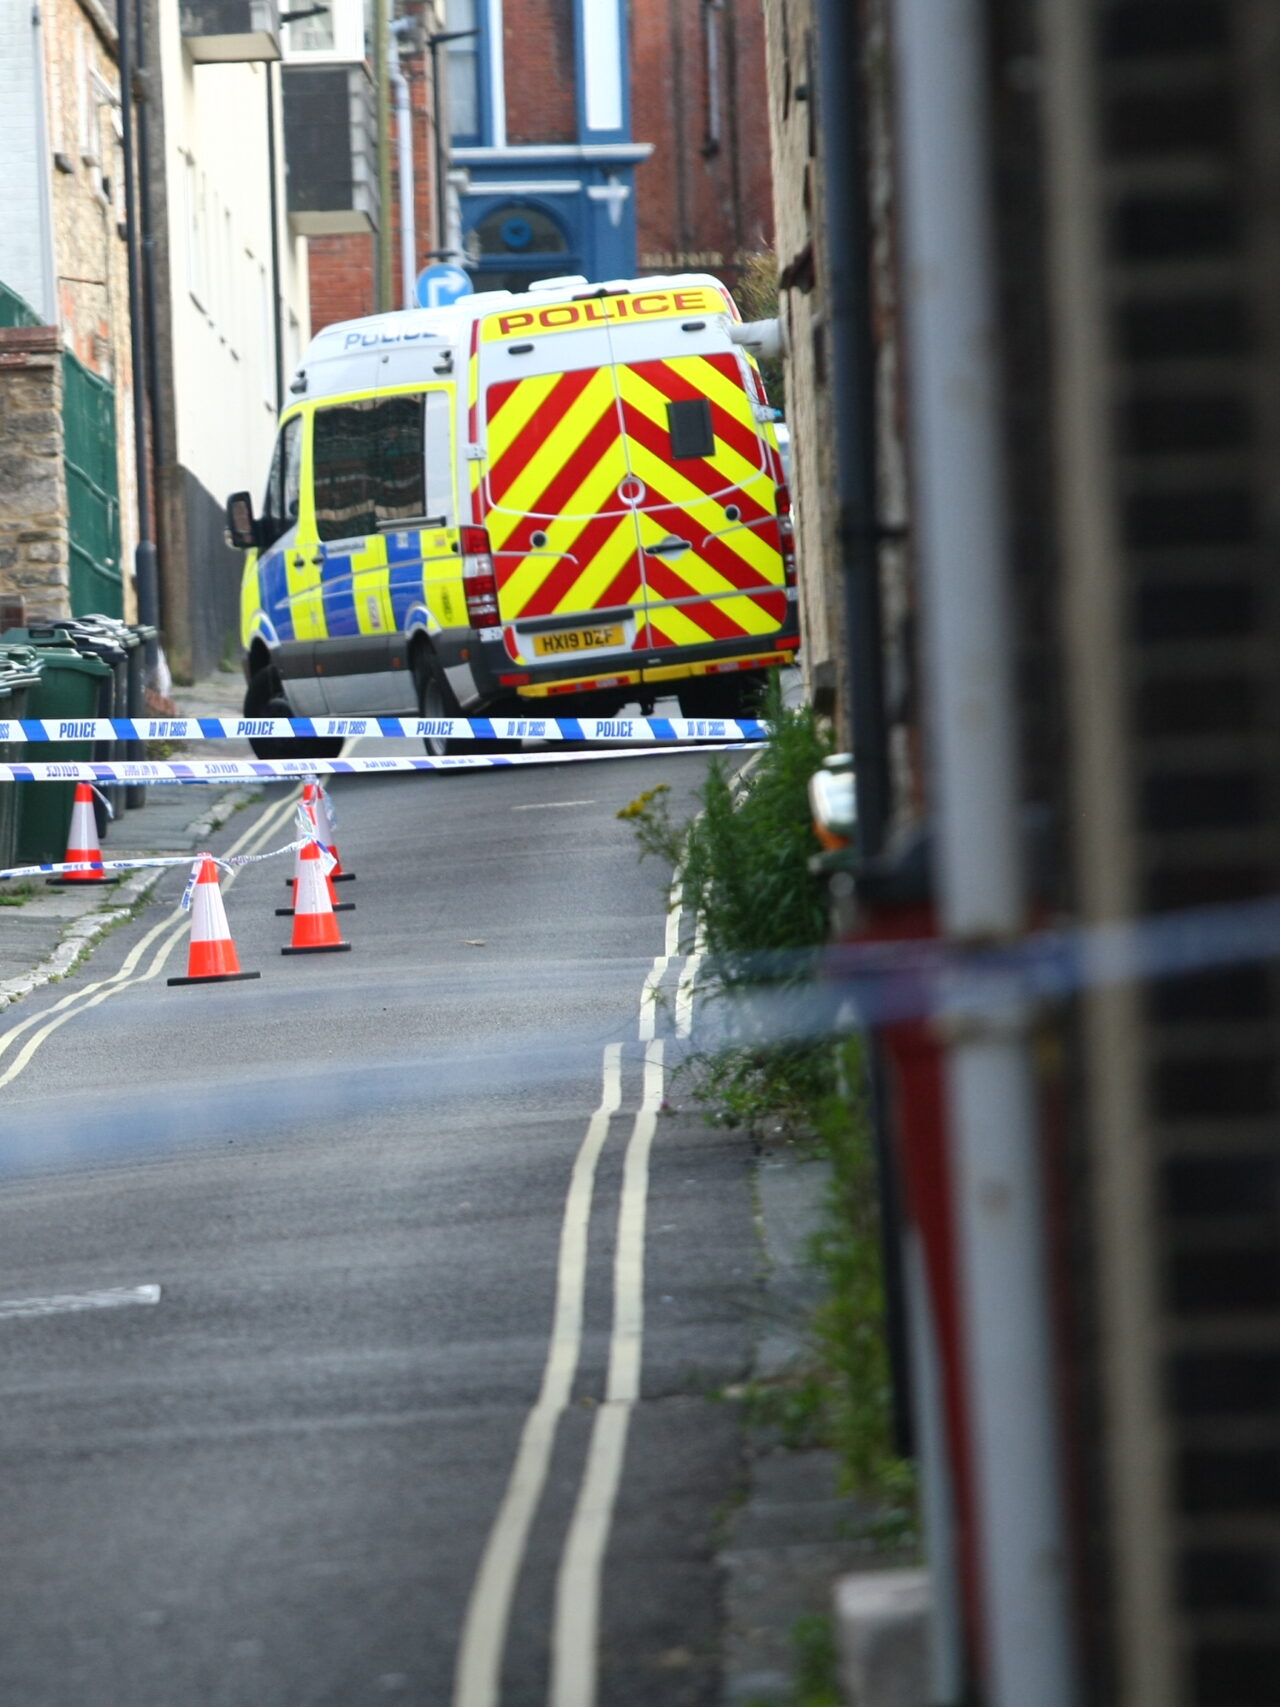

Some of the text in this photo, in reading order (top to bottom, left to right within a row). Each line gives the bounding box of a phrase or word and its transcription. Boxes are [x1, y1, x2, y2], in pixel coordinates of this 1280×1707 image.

[498, 291, 706, 335] POLICE
[542, 631, 579, 651] HX19
[59, 722, 96, 738] POLICE
[236, 721, 275, 735] POLICE
[416, 721, 455, 735] POLICE
[595, 721, 634, 737] POLICE
